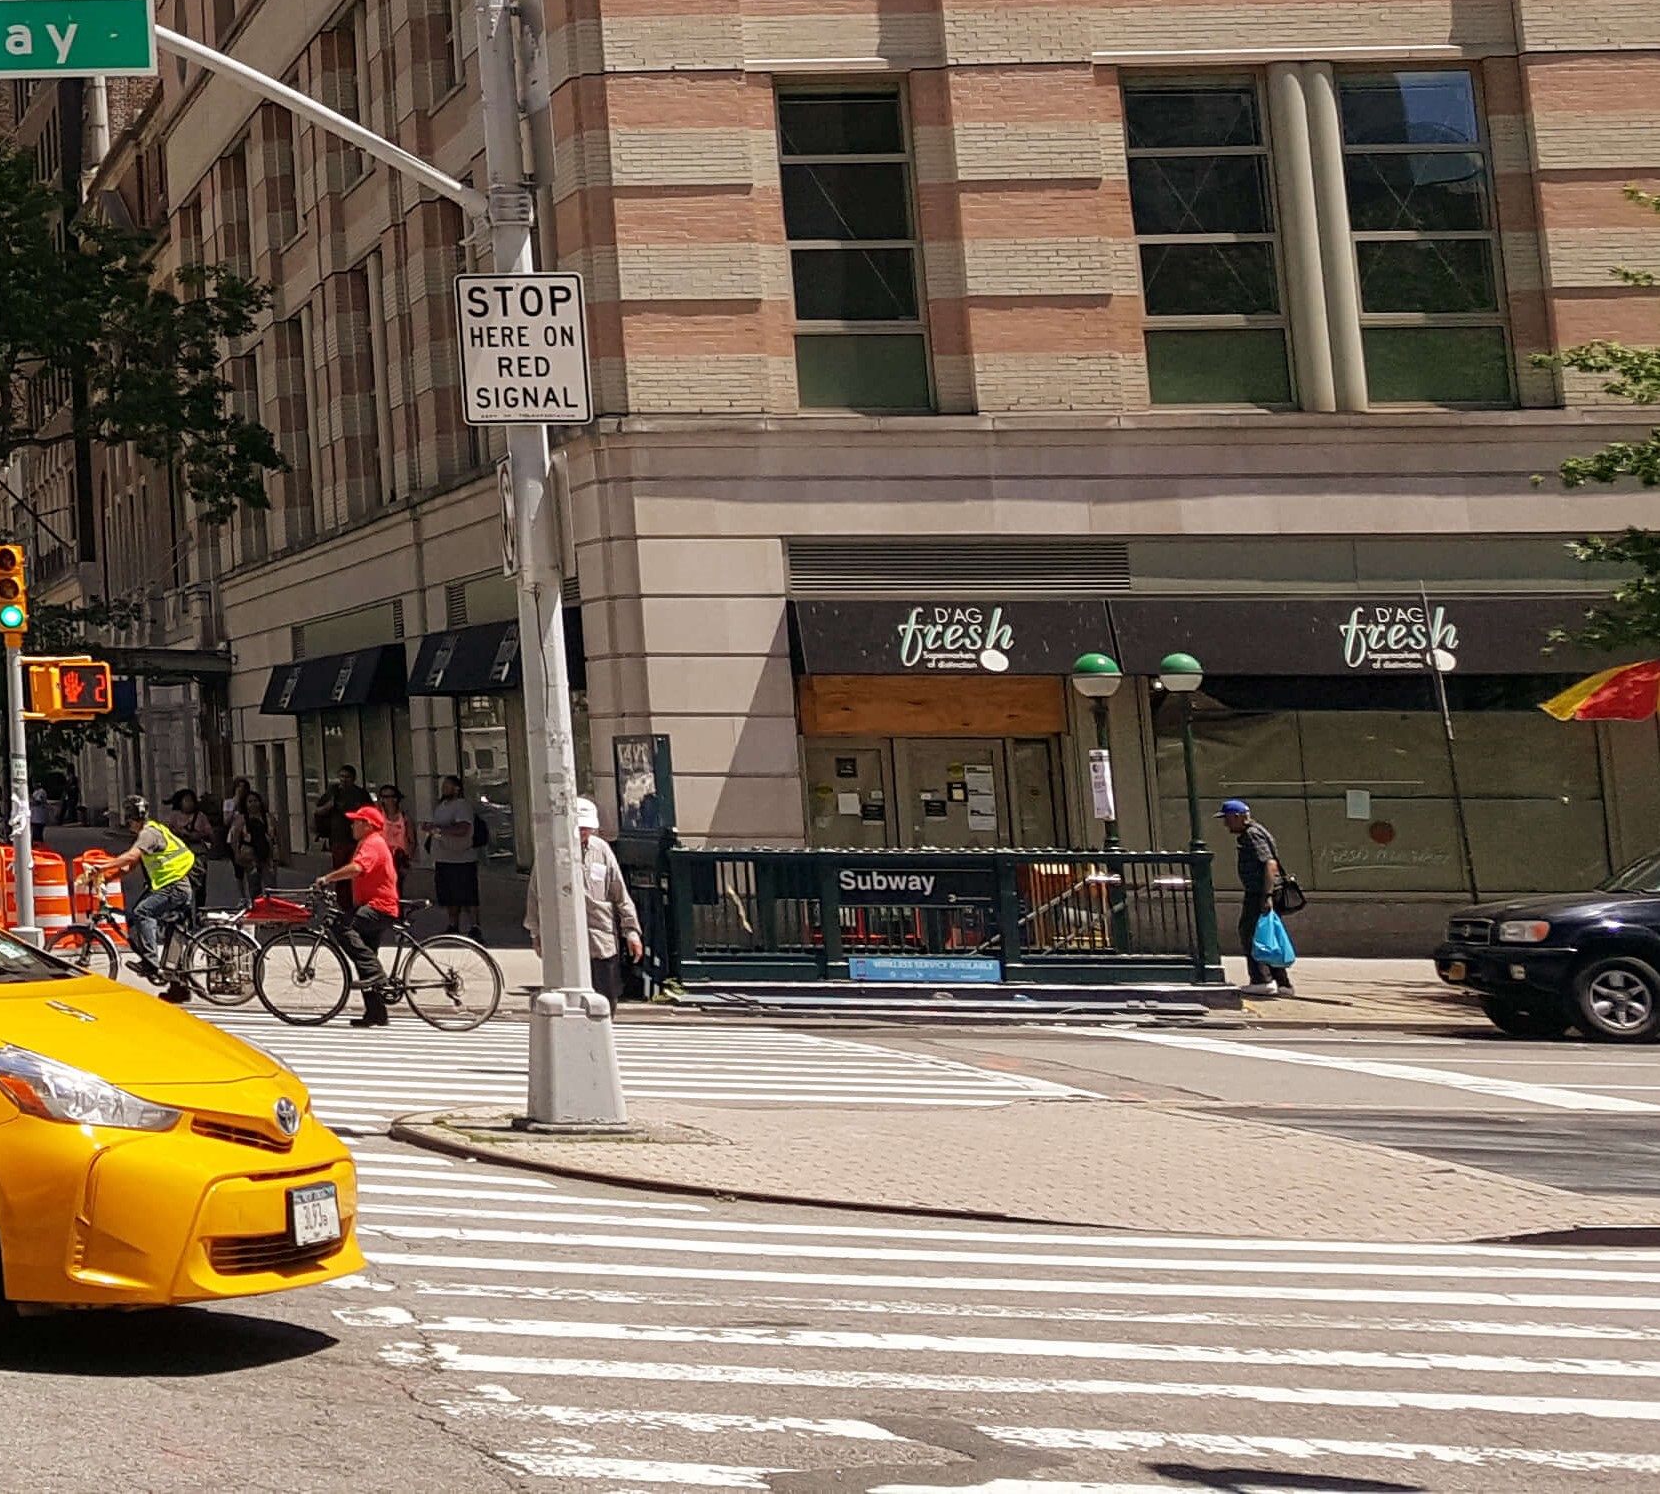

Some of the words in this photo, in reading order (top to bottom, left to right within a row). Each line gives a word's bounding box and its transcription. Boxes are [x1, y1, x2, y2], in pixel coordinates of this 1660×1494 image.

[467, 285, 572, 317] STOP
[470, 326, 530, 347] HERE
[543, 326, 574, 347] ON
[498, 356, 550, 377] RED
[476, 386, 578, 408] SIGNAL
[934, 607, 982, 624] D'AG
[1375, 607, 1425, 623] D'AG
[897, 607, 1014, 667] fresh
[1339, 607, 1459, 668] fresh
[94, 674, 106, 703] 2
[839, 870, 936, 896] Subway
